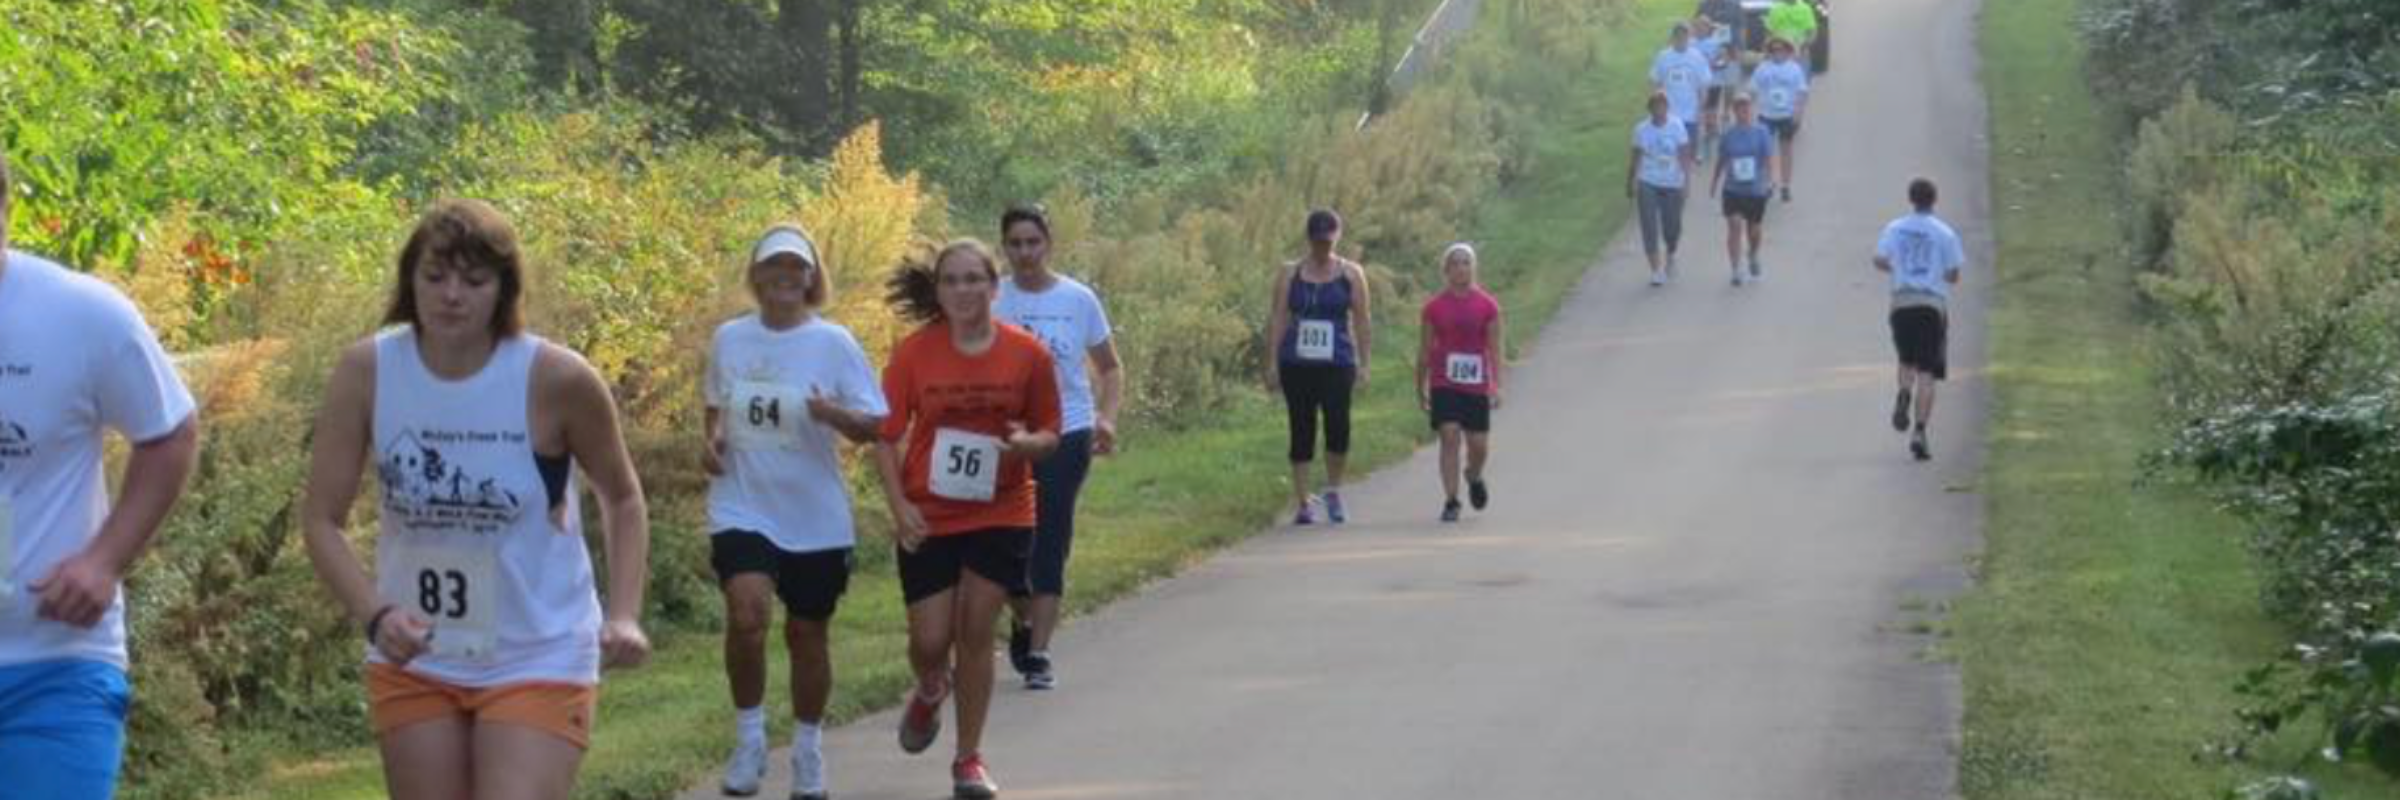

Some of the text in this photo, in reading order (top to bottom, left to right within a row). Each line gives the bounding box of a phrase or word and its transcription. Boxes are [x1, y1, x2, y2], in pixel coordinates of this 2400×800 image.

[1302, 327, 1328, 347] 101
[1453, 361, 1478, 379] 104
[749, 396, 780, 428] 64
[948, 445, 981, 477] 56
[419, 567, 468, 619] 83
